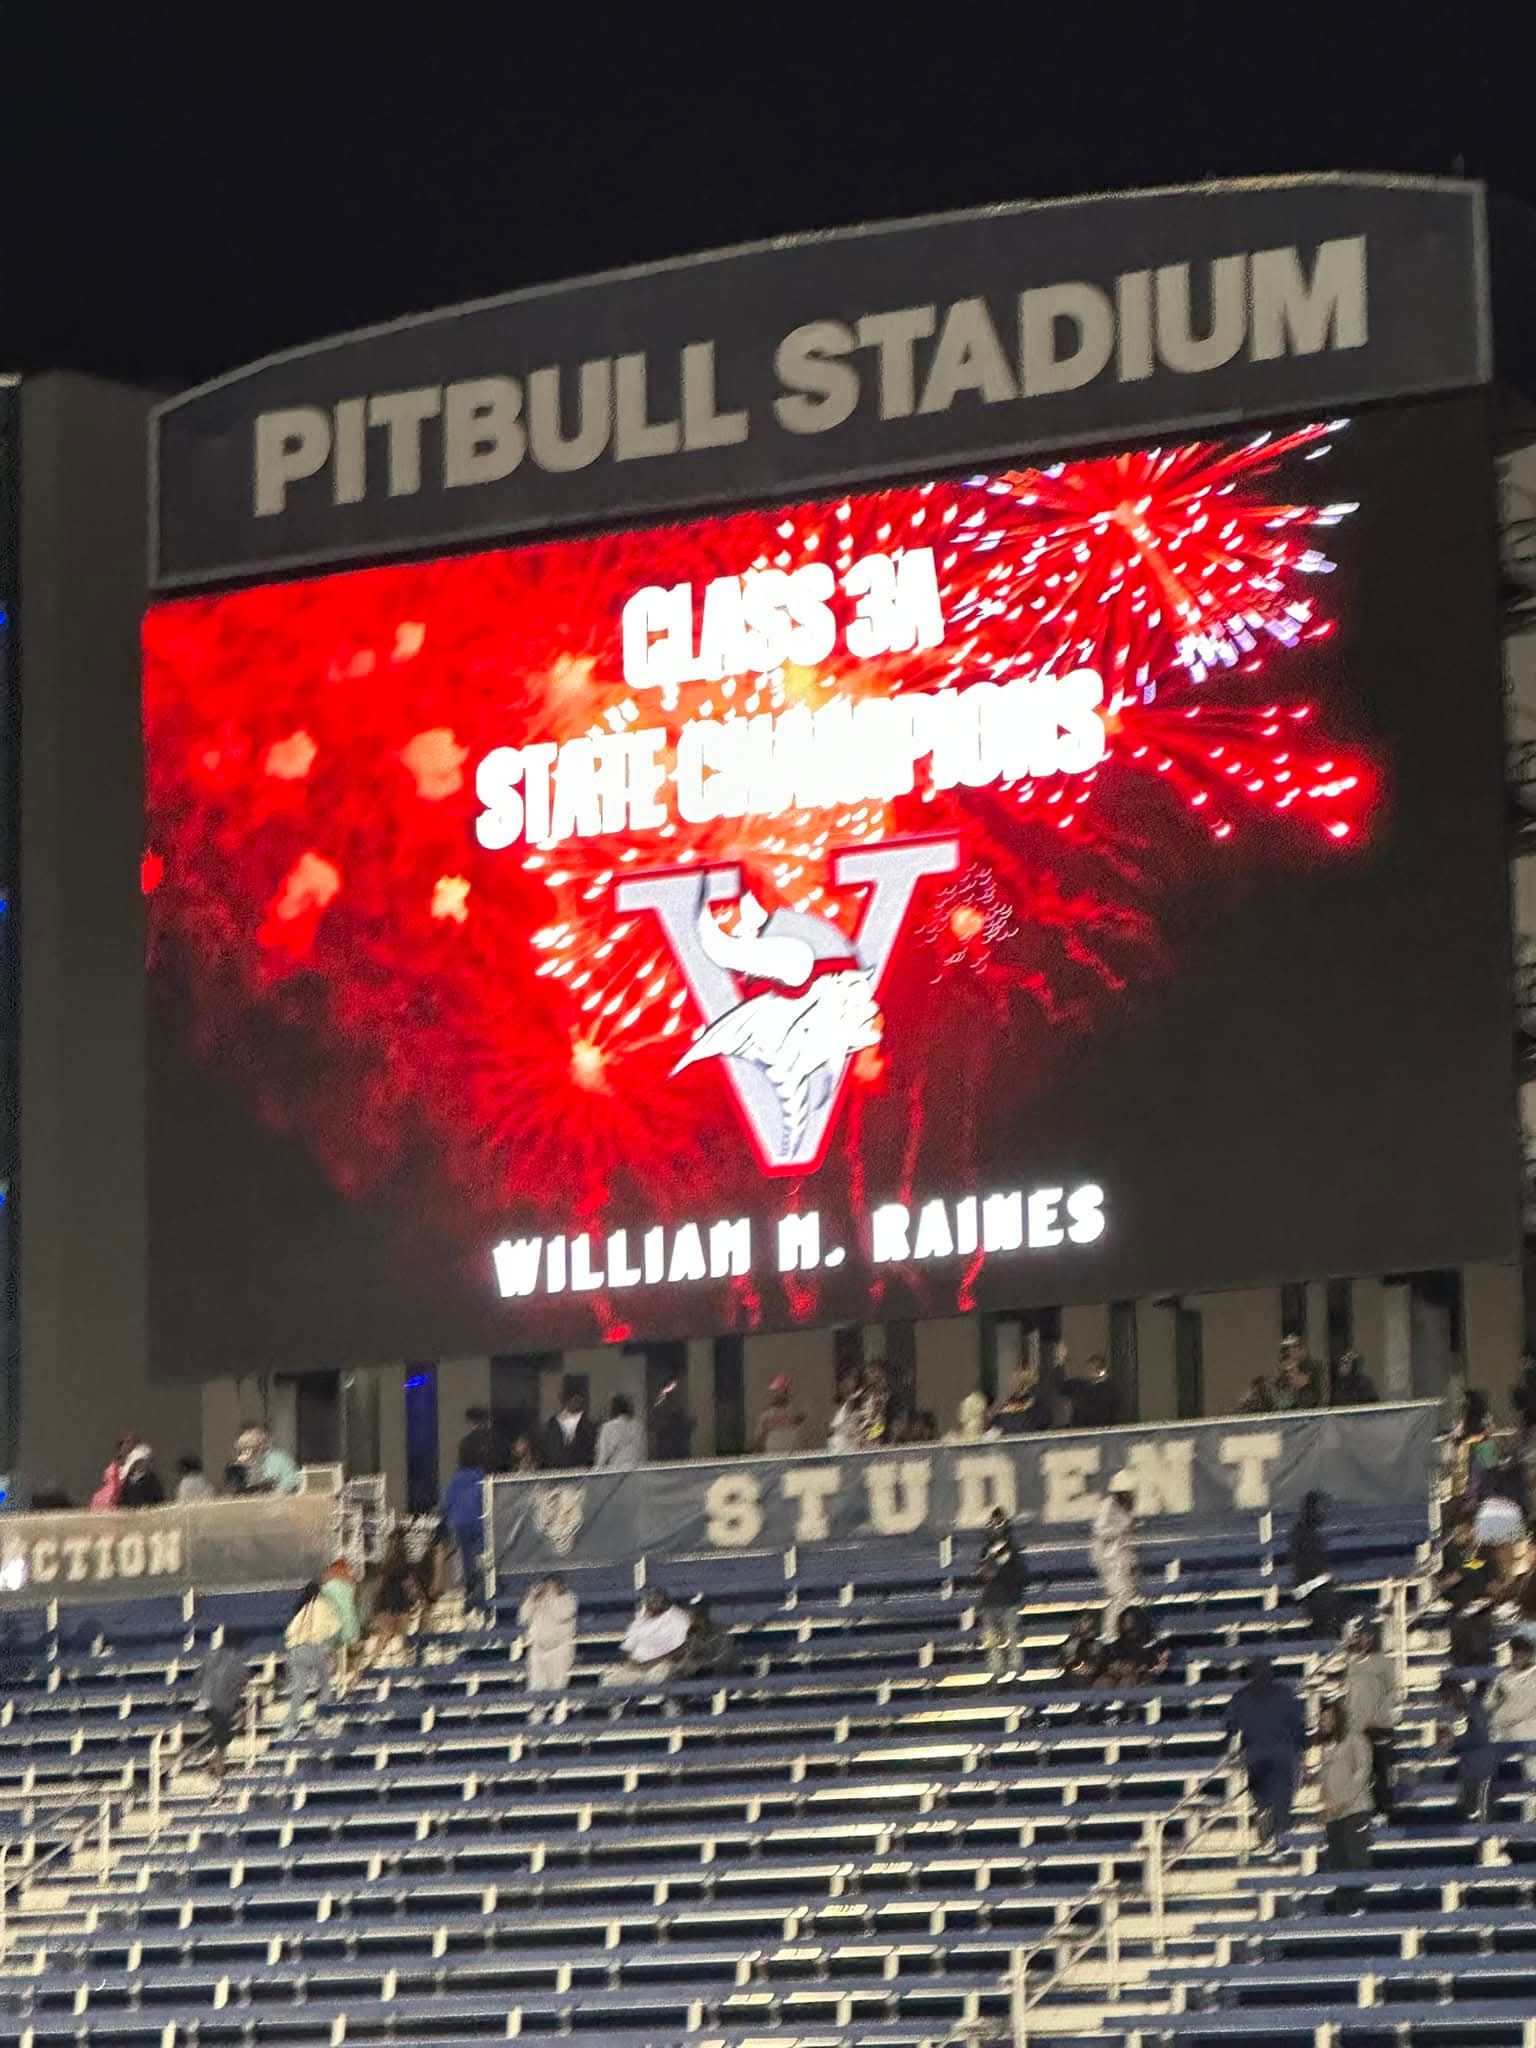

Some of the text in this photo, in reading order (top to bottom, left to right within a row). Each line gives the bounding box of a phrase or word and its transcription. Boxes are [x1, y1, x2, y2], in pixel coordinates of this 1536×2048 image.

[252, 236, 1370, 517] PITBULL STADIUM
[622, 547, 945, 689] CLASS 3A
[475, 667, 1106, 850] STATE CHAMPIONS
[492, 1217, 752, 1298] WILLIAM
[872, 1185, 1106, 1263] RAINES
[704, 1431, 1283, 1547] STUDENT
